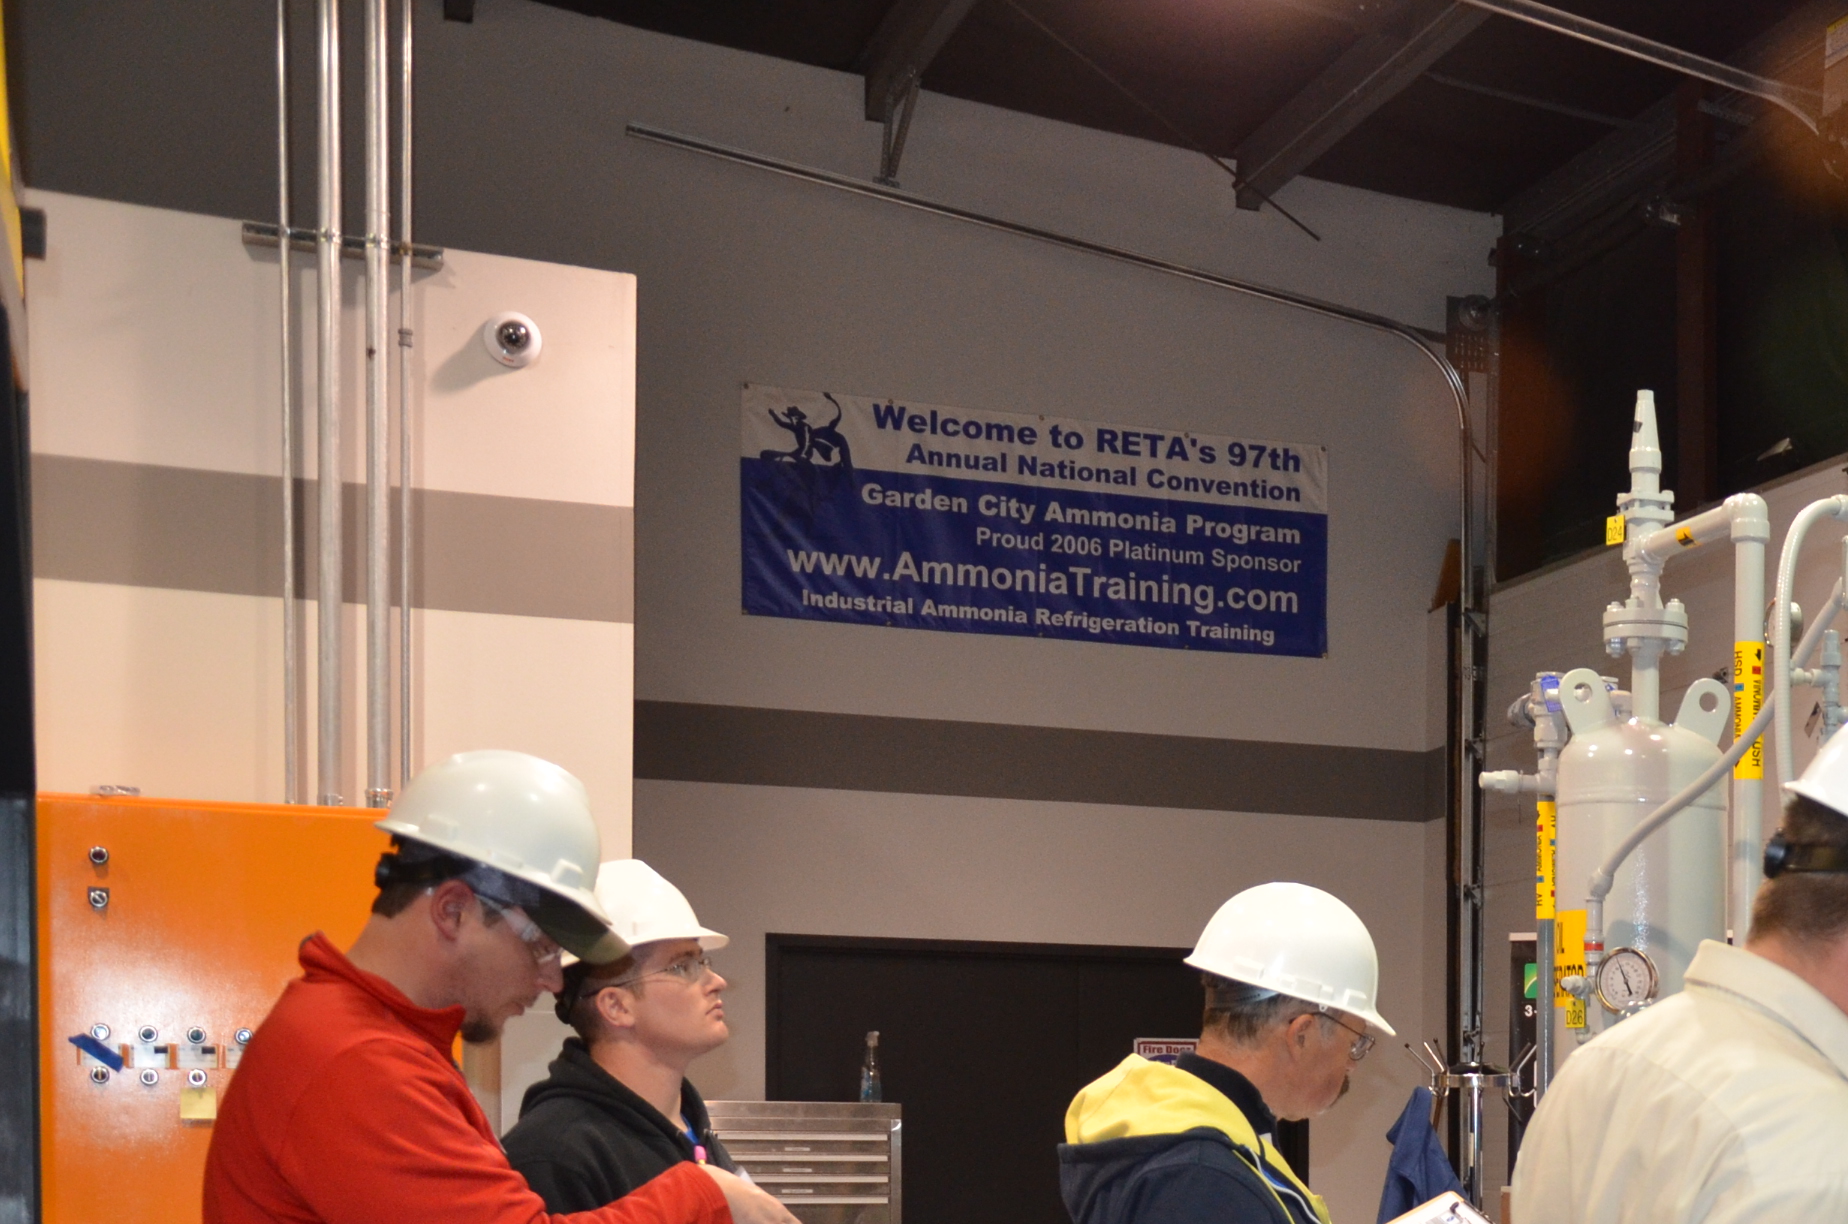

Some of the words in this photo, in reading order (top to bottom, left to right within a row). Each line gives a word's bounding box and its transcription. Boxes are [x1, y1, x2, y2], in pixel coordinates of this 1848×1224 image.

[873, 403, 1038, 445] Welcome
[1050, 424, 1084, 450] to
[1097, 428, 1217, 464] RETA's
[1227, 442, 1300, 473] 97th
[906, 443, 1007, 473] Annual
[1018, 455, 1137, 486] National
[1146, 467, 1300, 502] Convention
[861, 483, 968, 514] Garden
[978, 494, 1035, 524] City
[1044, 501, 1176, 534] Ammonia
[1186, 514, 1300, 545] Program
[1607, 526, 1622, 542] D24
[976, 527, 1044, 550] Proud
[1051, 534, 1102, 556] 2006
[1109, 539, 1204, 566] Platinum
[1211, 548, 1301, 573] Sponsor
[787, 549, 1298, 614] www.AmmoniaTraining.com
[802, 589, 913, 615] Industrial
[921, 599, 1027, 624] Ammonia
[1035, 608, 1179, 635] Refrigeration
[1186, 620, 1275, 646] Training
[1566, 1009, 1583, 1026] D26
[1143, 1045, 1164, 1054] Fire
